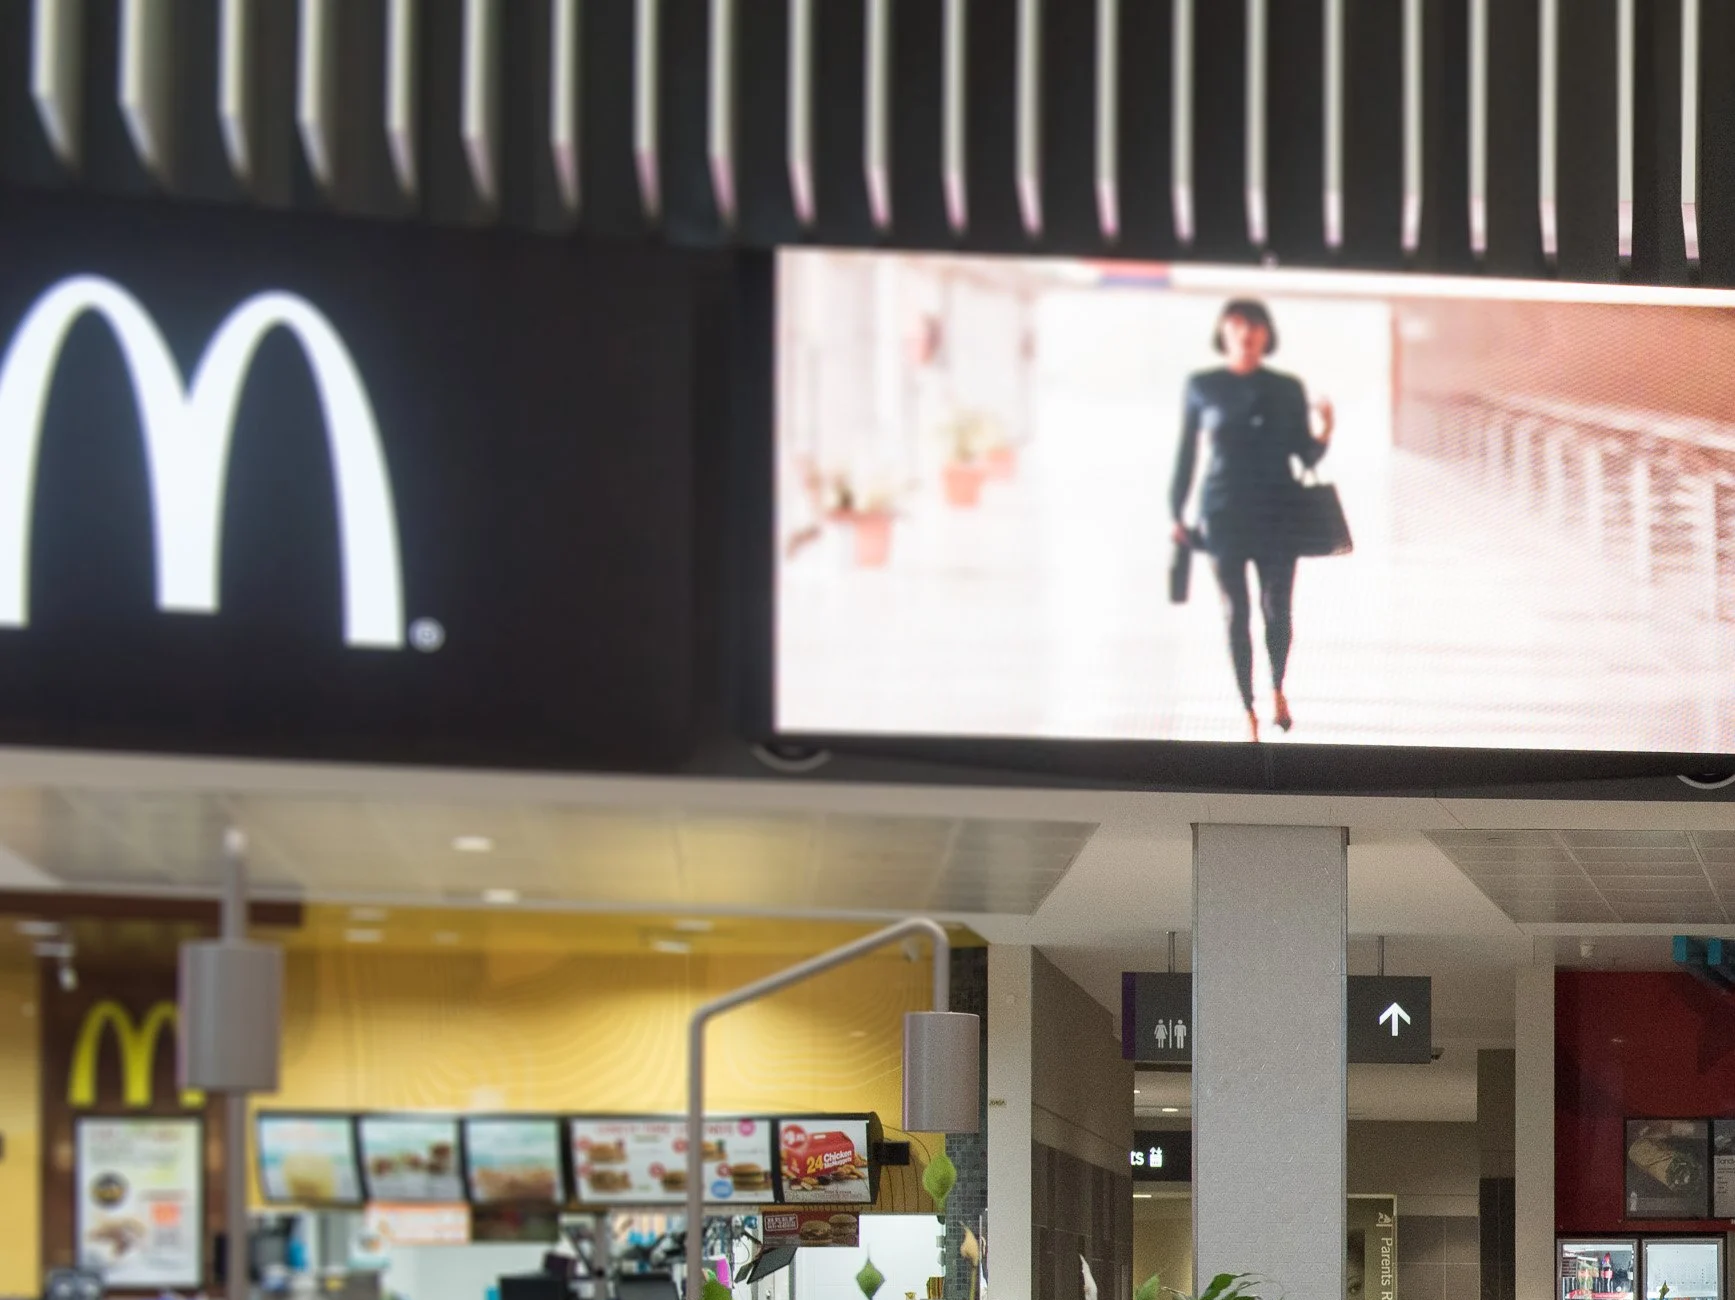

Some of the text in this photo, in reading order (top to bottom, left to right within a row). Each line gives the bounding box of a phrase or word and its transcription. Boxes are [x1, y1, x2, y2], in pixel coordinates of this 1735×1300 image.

[806, 1150, 852, 1174] 24 Chicken
[1381, 1237, 1393, 1287] Parents
